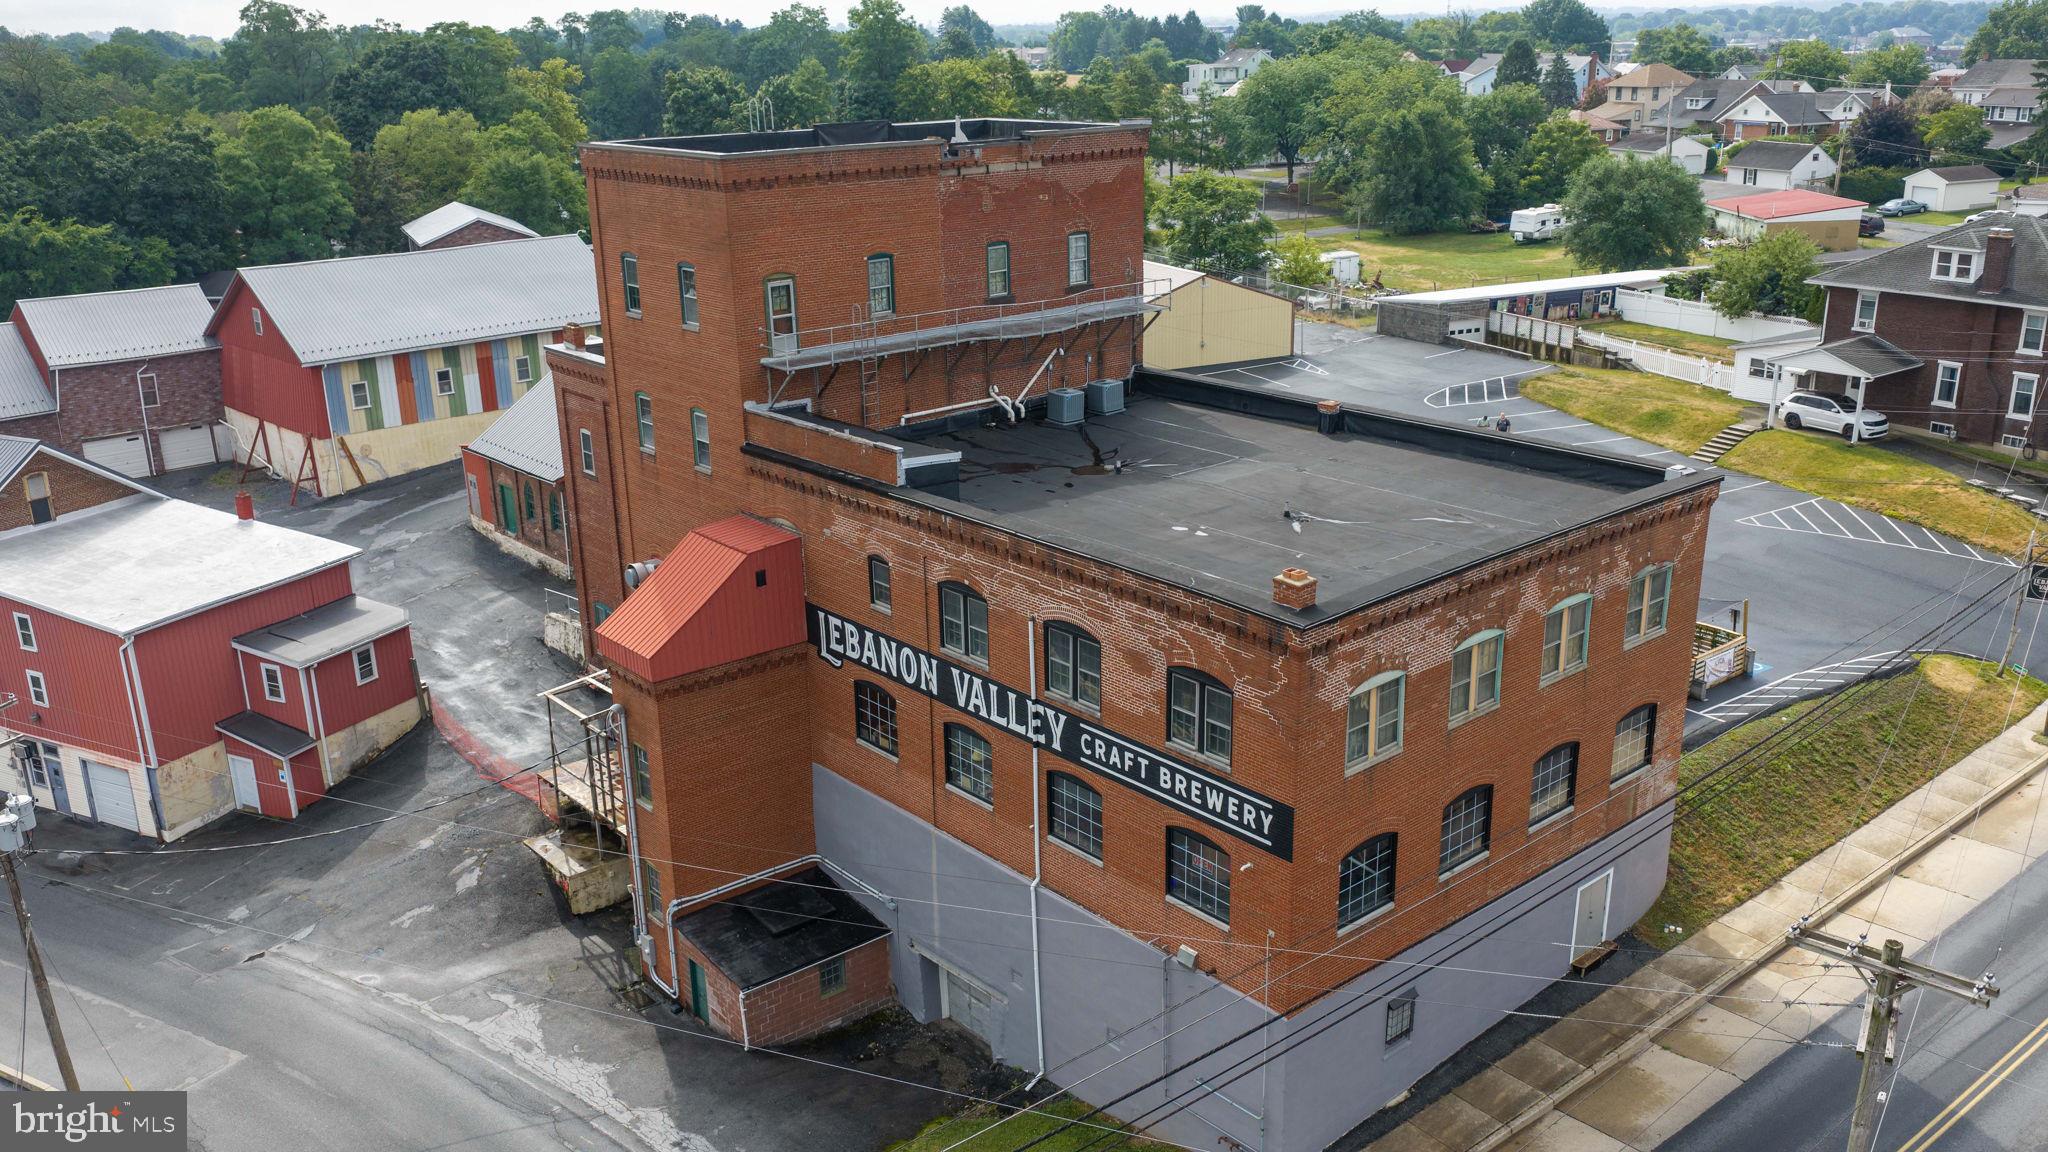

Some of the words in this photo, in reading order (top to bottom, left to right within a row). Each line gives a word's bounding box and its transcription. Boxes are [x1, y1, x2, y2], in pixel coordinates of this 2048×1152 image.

[817, 609, 938, 696] LEBANON
[950, 667, 1067, 752] VALLEY
[1080, 733, 1147, 780] CRAFT
[1159, 766, 1273, 836] BREWERY
